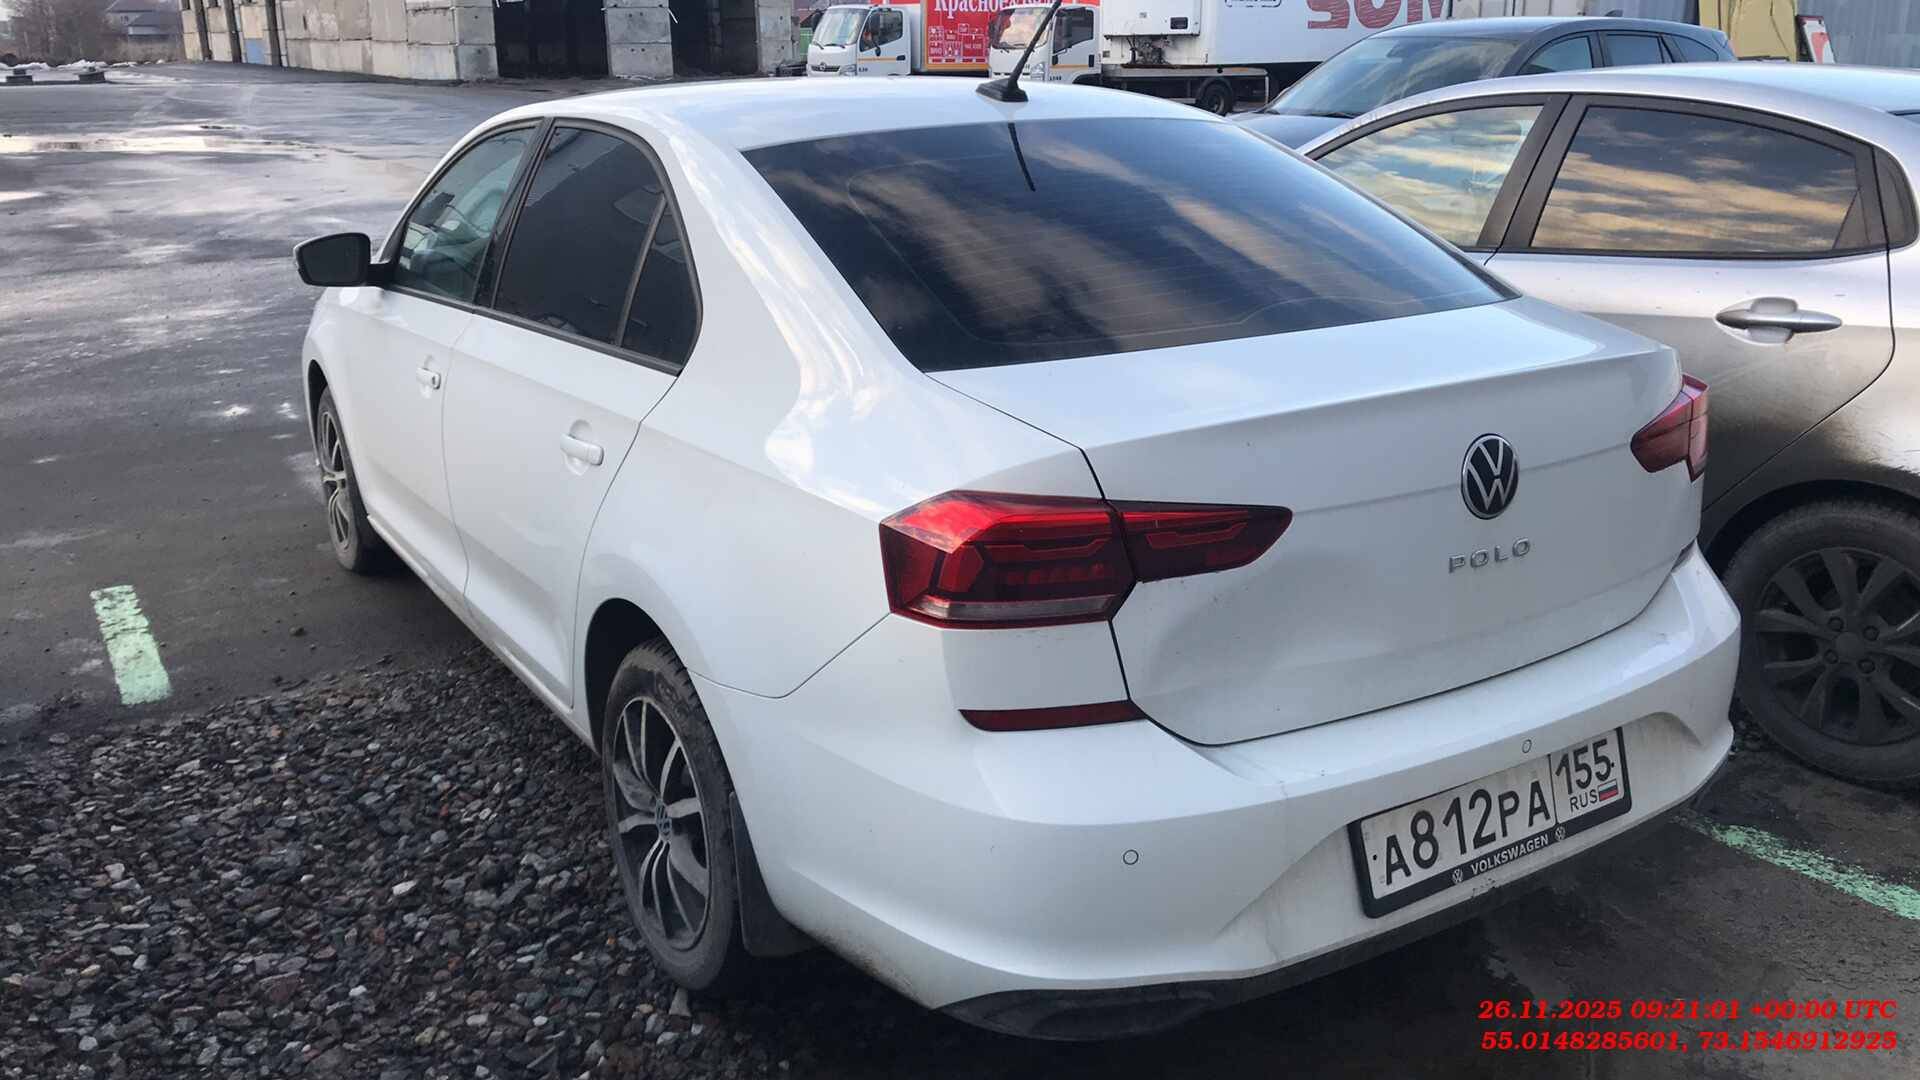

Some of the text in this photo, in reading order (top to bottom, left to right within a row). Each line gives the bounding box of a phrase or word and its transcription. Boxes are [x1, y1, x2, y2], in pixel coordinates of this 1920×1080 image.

[1448, 537, 1531, 573] POLO
[1555, 738, 1611, 795] 155
[1569, 789, 1598, 813] RUS
[1470, 834, 1549, 876] VOLKSWAGEN
